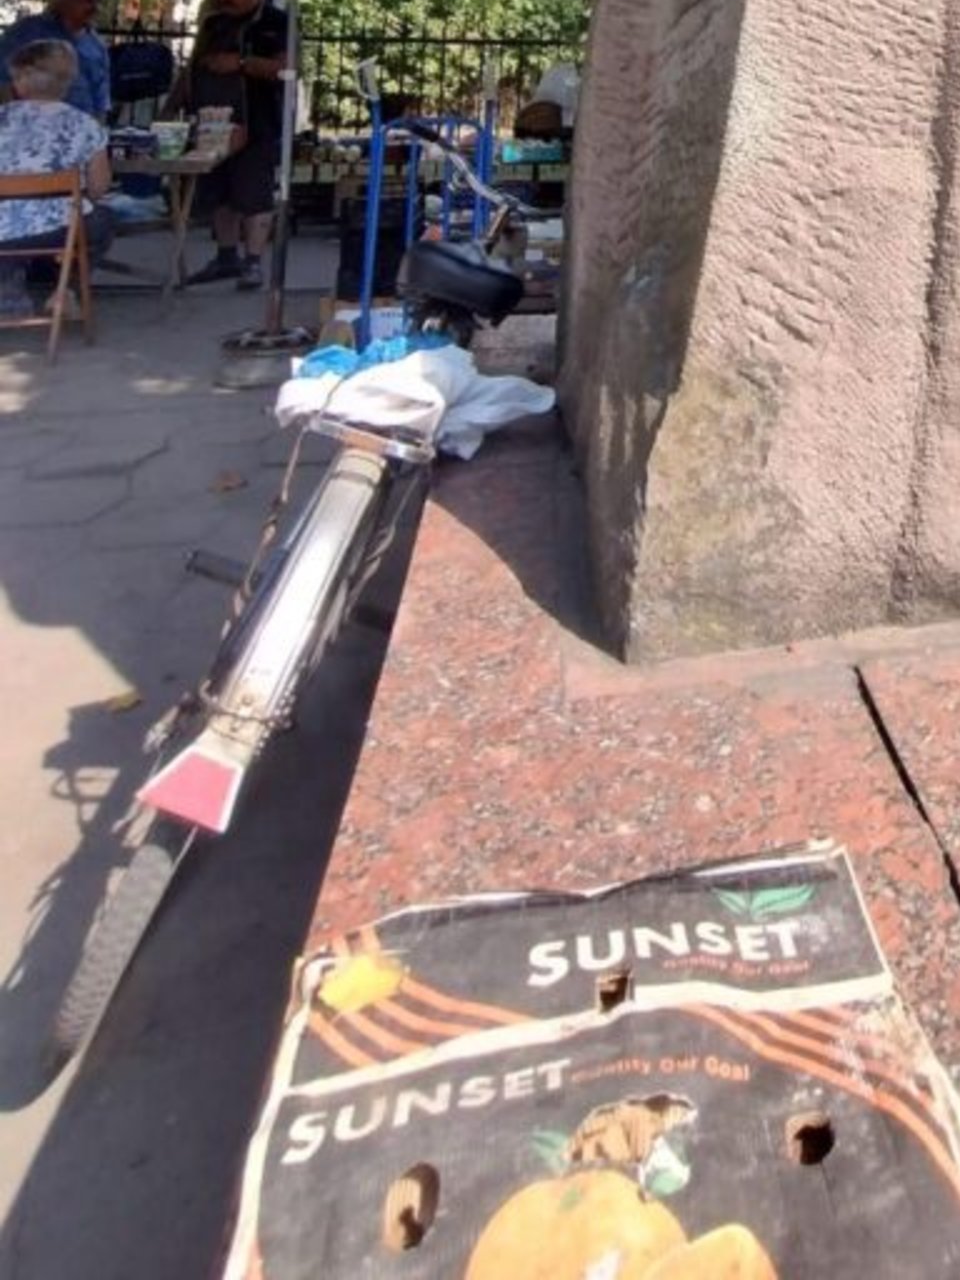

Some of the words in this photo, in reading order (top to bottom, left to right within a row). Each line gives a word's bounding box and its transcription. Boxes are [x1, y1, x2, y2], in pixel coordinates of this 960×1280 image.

[526, 919, 802, 988] SUNSET
[658, 1054, 697, 1076] Our
[703, 1053, 749, 1082] Goal
[280, 1057, 572, 1165] SUNSET
